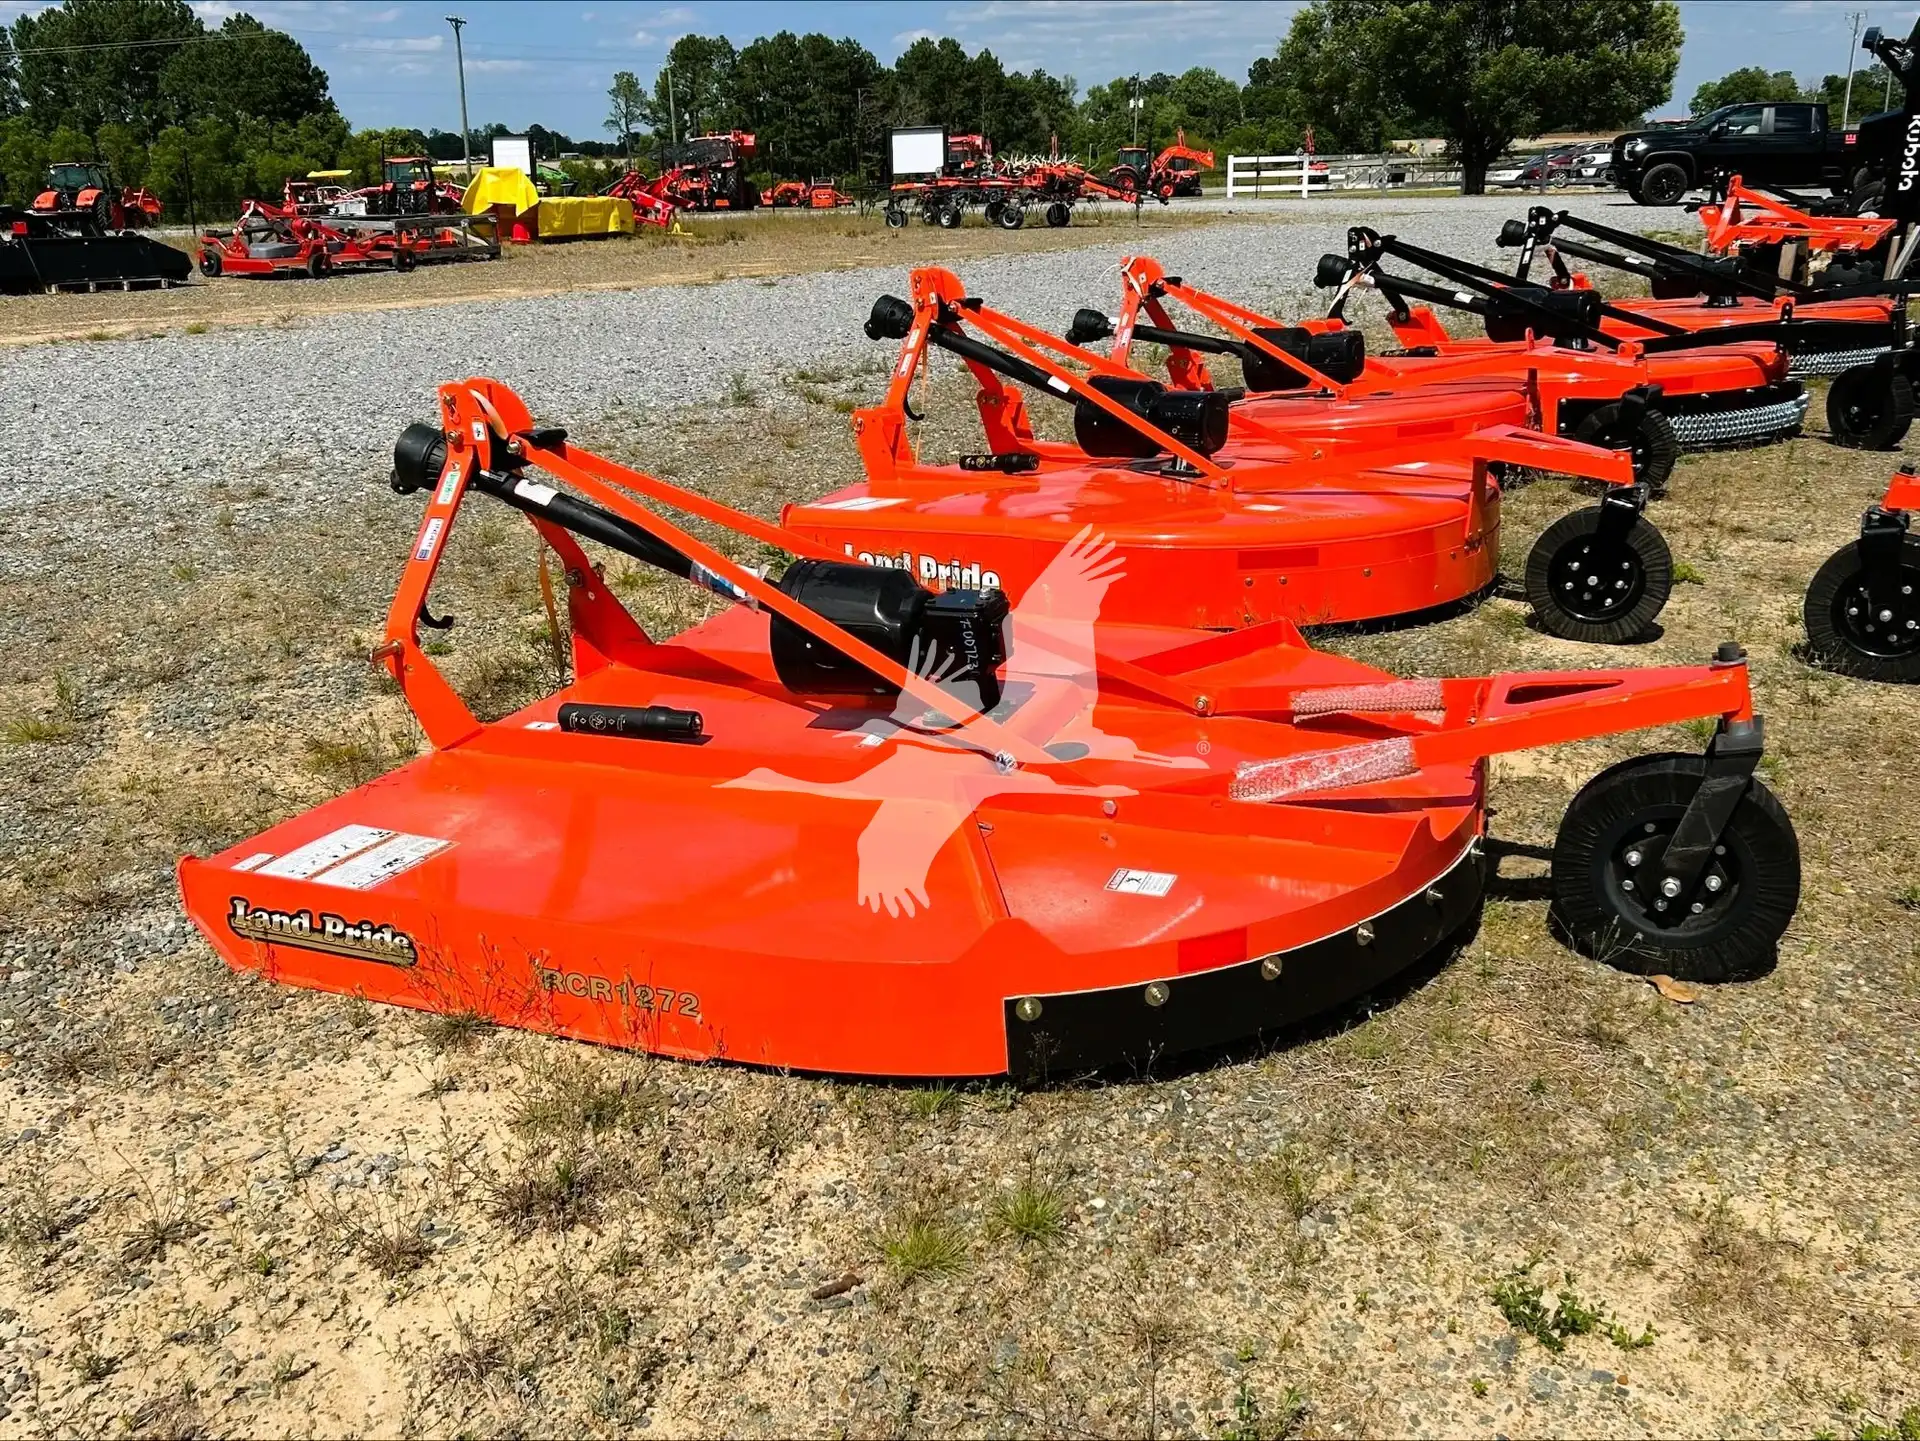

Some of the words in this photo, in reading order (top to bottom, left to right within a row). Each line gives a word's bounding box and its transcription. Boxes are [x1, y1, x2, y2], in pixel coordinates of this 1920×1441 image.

[1898, 114, 1920, 191] Kubota
[233, 898, 313, 938] Land
[322, 915, 411, 955] Pride
[541, 967, 700, 1018] RCR1272
